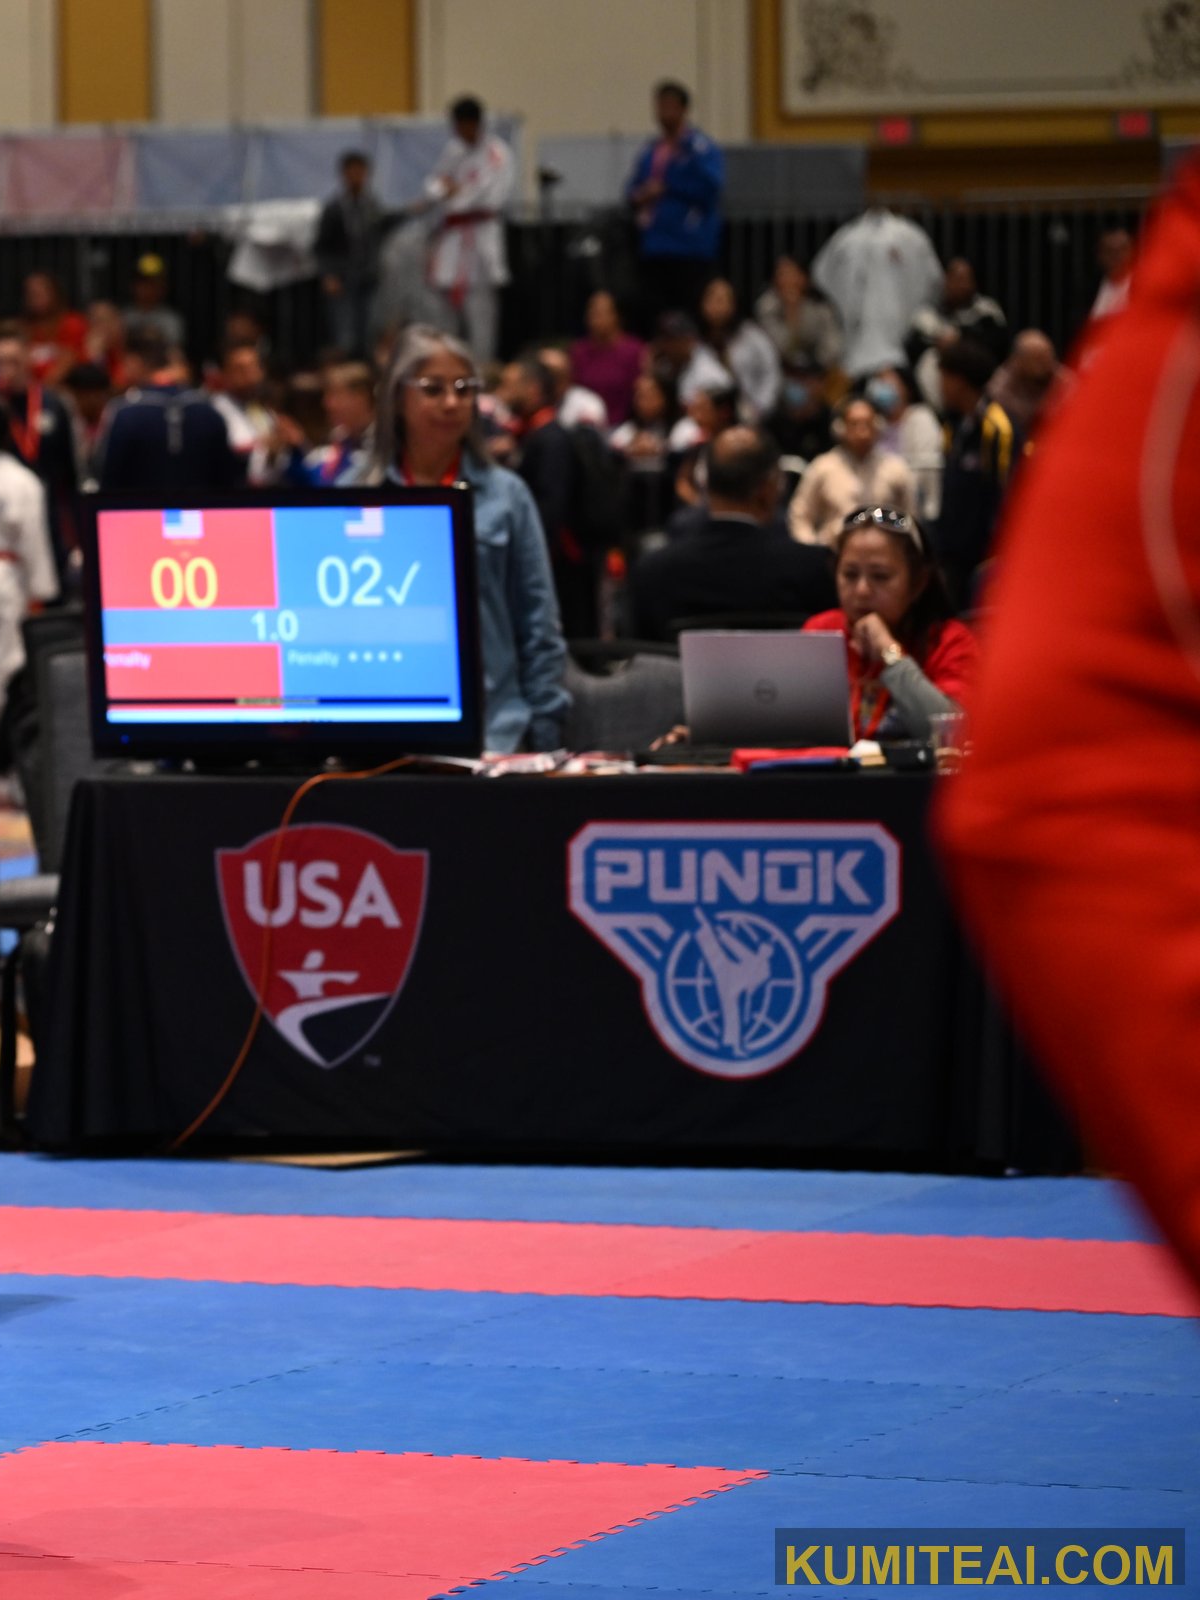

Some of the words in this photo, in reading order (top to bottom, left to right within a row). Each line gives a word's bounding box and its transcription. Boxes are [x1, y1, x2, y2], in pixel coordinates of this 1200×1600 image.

[151, 557, 218, 609] 00
[316, 555, 383, 608] 02
[250, 609, 300, 642] 1.0
[243, 860, 402, 929] USA
[594, 848, 873, 905] PUNOK
